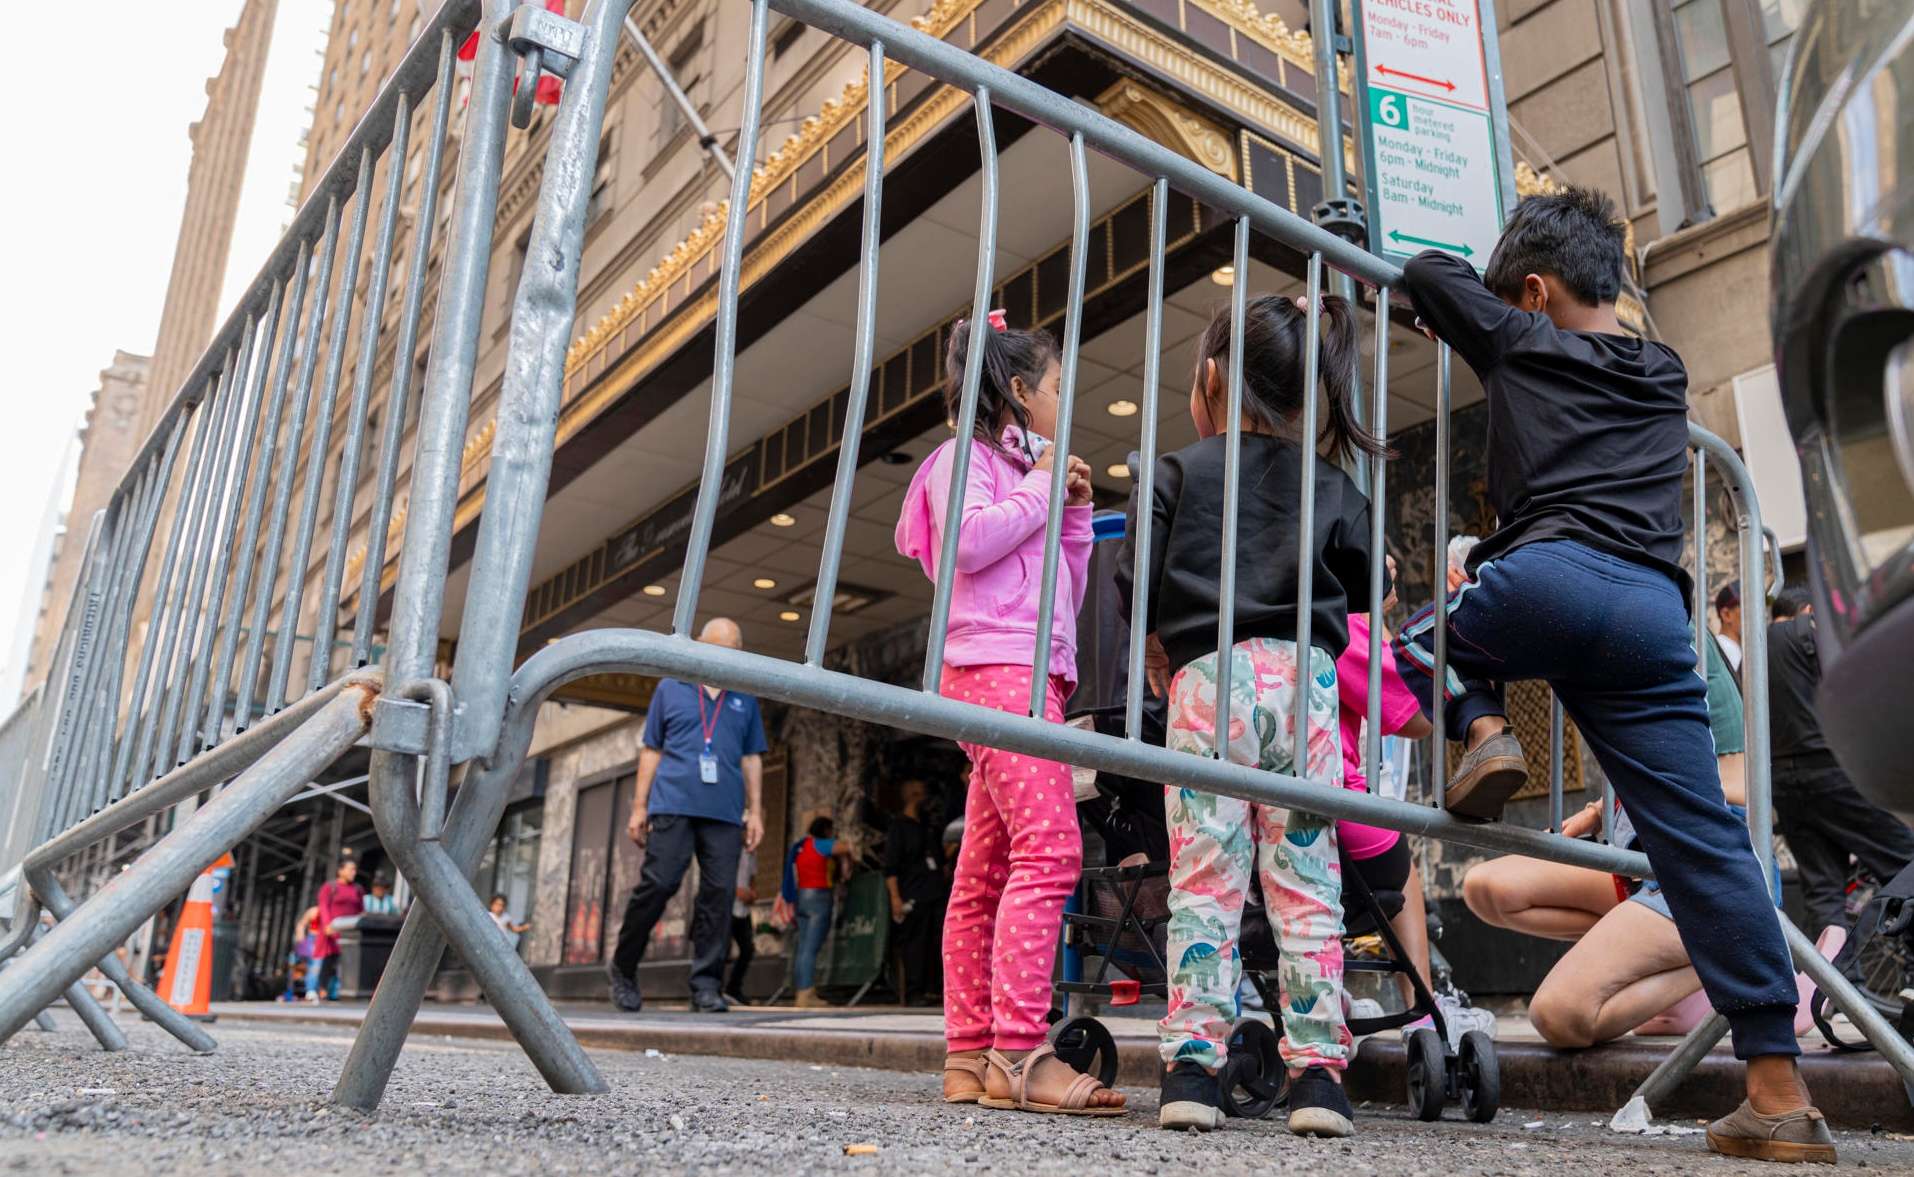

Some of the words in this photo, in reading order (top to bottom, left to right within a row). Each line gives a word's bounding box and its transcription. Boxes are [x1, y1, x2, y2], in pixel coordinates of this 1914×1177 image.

[1370, 0, 1433, 18] HICLES
[1436, 8, 1470, 27] ONLY
[1368, 11, 1408, 32] Monday
[1418, 24, 1450, 44] Friday
[1370, 25, 1393, 40] 7am
[1403, 34, 1429, 49] 6pm
[1379, 94, 1401, 126] 6
[1413, 115, 1455, 132] metered
[1415, 126, 1451, 143] parking
[1378, 136, 1424, 156] Monday
[1434, 147, 1469, 168] Friday
[1379, 151, 1405, 166] 6pm
[1415, 158, 1460, 178] Midnight
[1382, 172, 1434, 196] Saturday
[1383, 188, 1408, 203] 8am
[1418, 196, 1464, 216] Midnight
